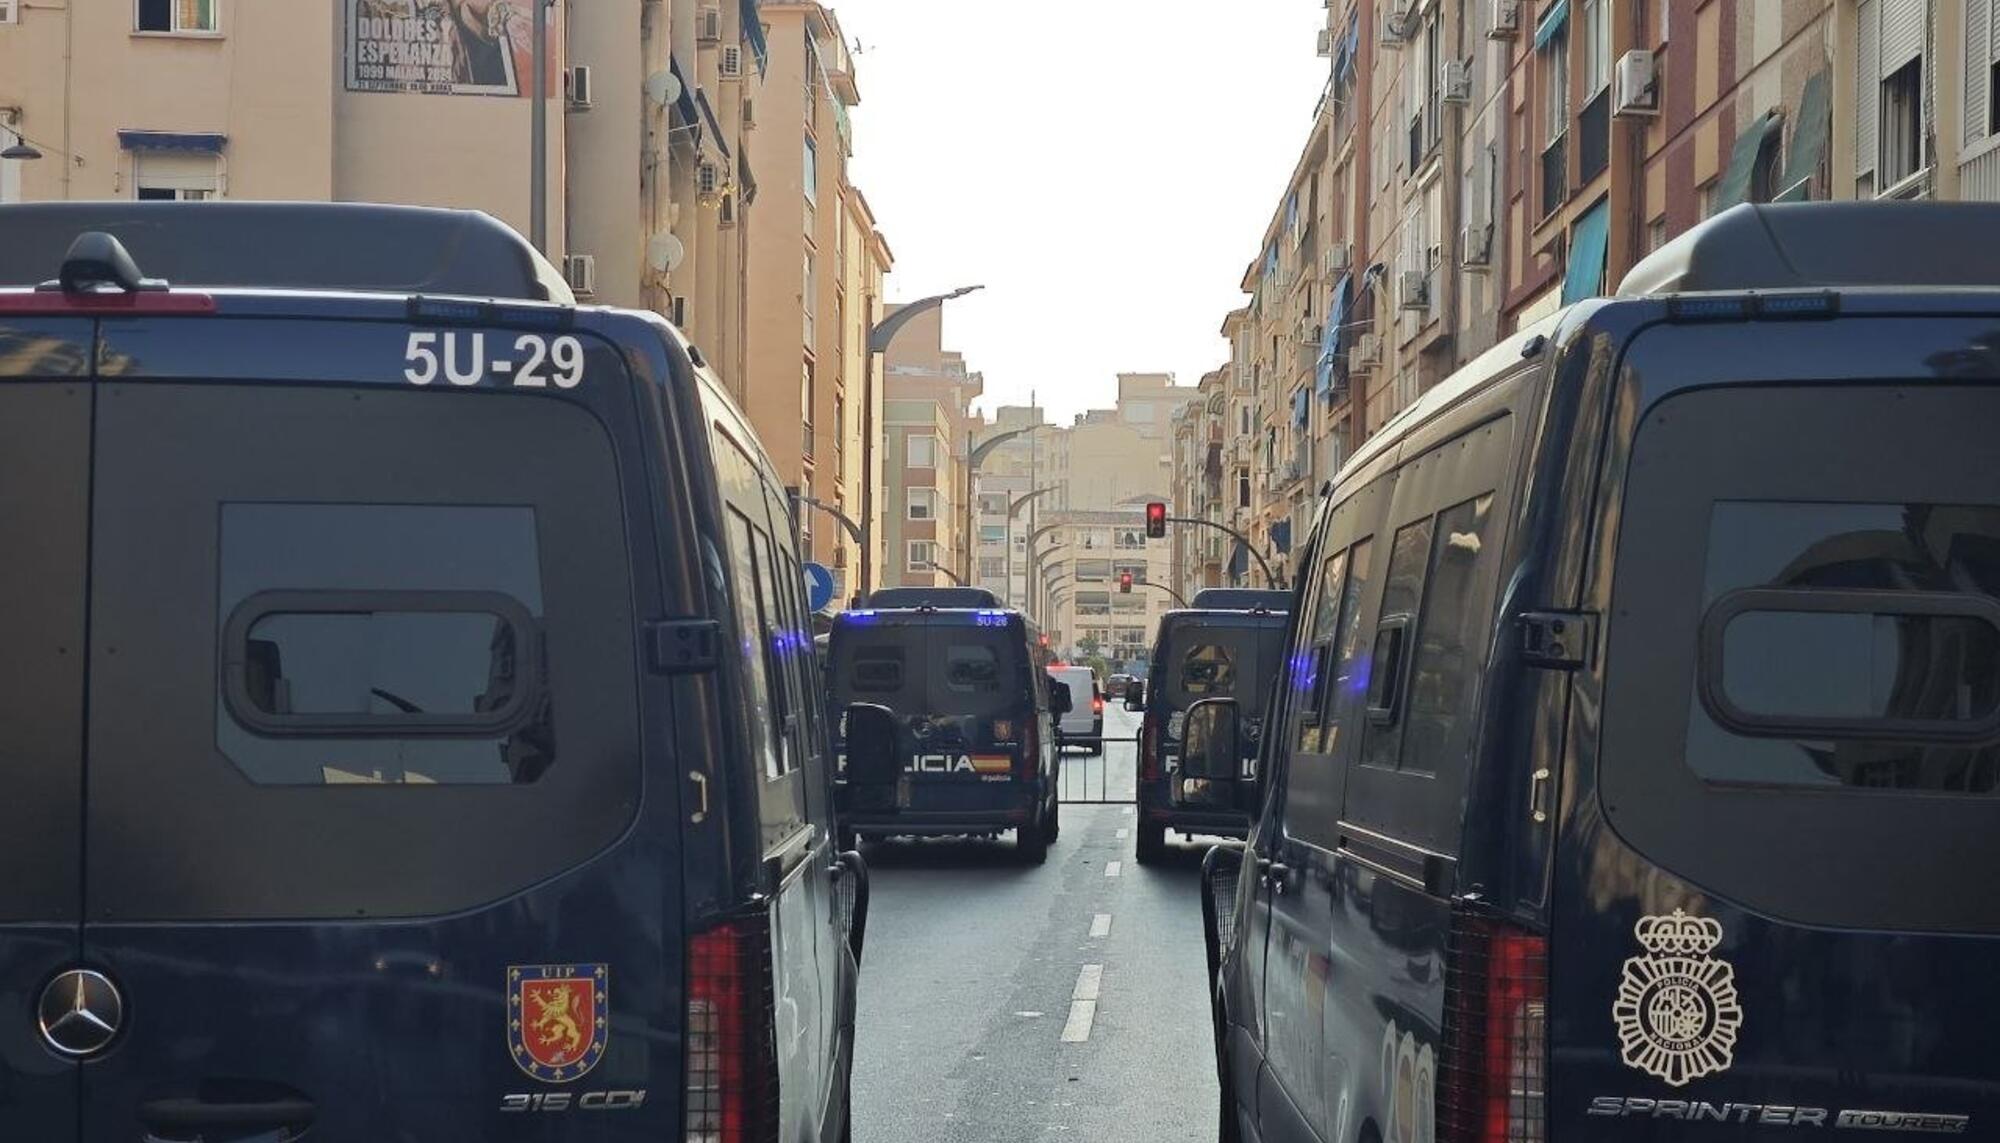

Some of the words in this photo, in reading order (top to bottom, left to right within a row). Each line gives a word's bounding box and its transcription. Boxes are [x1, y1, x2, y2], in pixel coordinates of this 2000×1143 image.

[358, 17, 437, 41] DOLORES
[440, 17, 452, 42] Y
[358, 41, 453, 65] ESPERANZA
[359, 65, 384, 79] 1999
[404, 332, 584, 388] 5U-29
[541, 967, 575, 978] UIP
[1649, 1033, 1707, 1051] NACIONAL
[500, 1093, 572, 1112] 315
[579, 1089, 646, 1110] CDI
[1587, 1096, 1828, 1128] SPRINTER
[1844, 1112, 1966, 1134] TOURER
